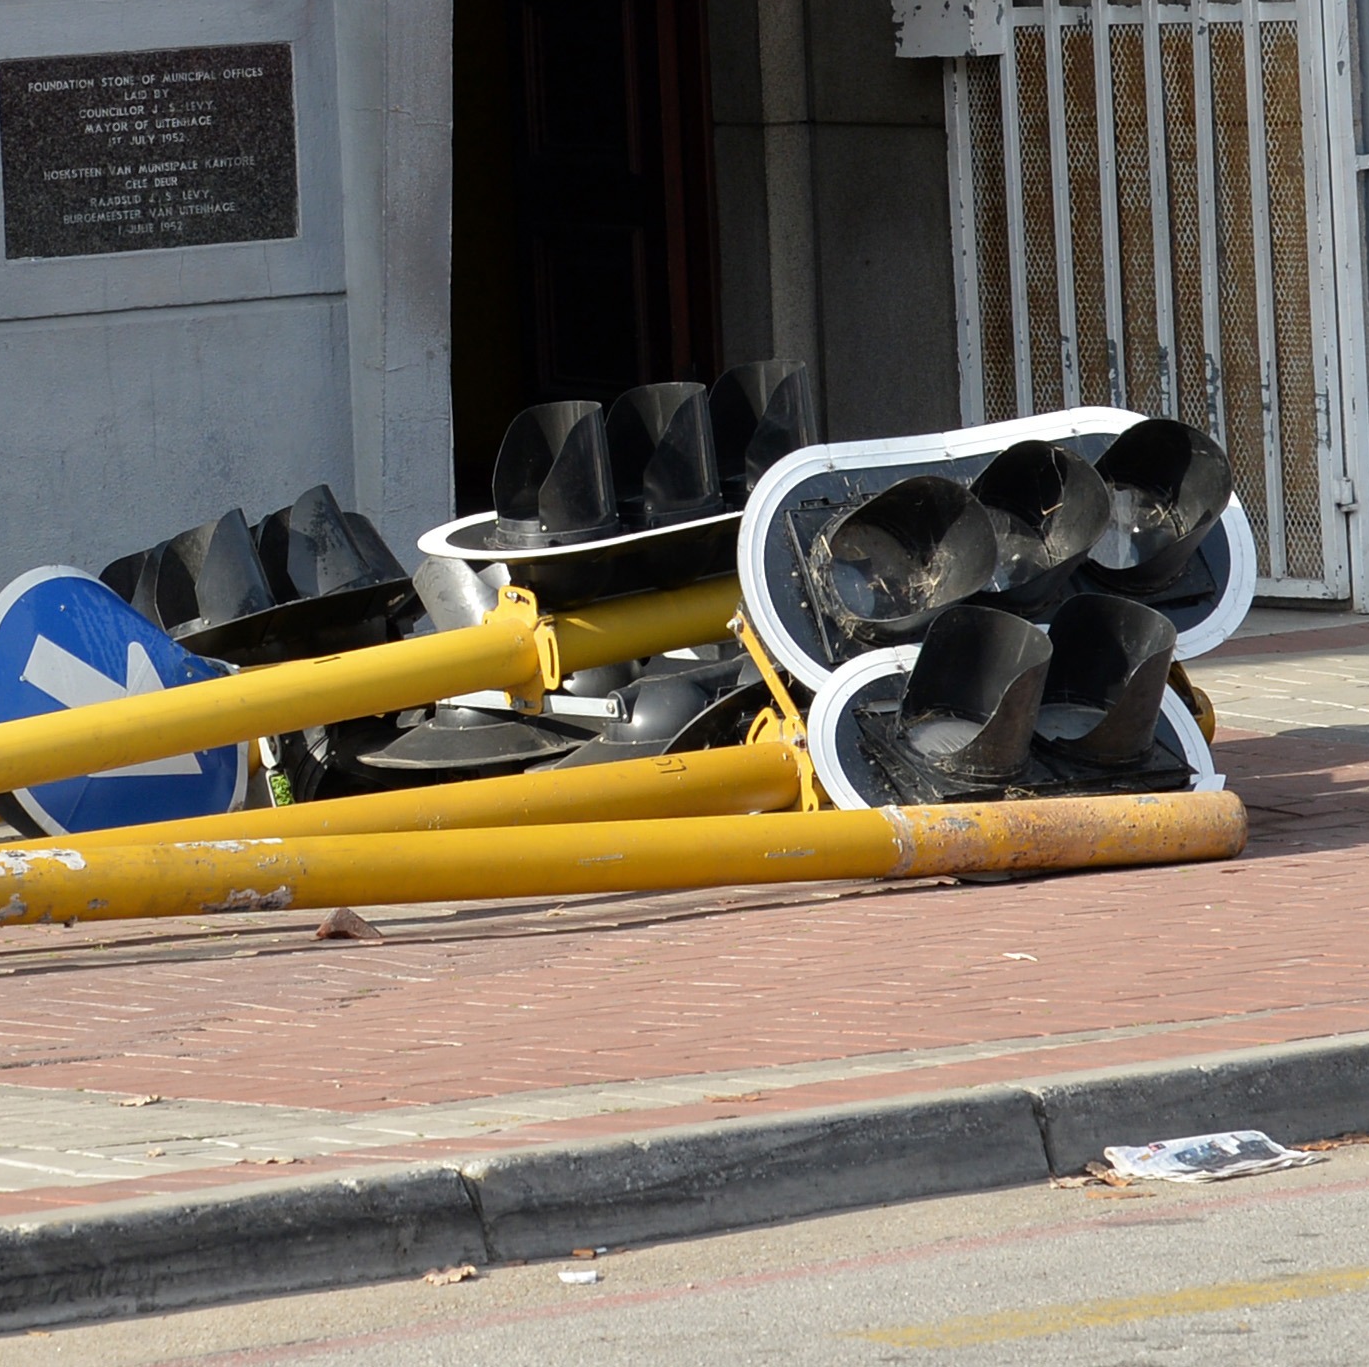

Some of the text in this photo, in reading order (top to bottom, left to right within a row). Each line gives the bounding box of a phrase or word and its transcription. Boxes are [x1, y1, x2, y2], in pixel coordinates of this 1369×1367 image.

[28, 67, 263, 92] FOUNDATION STONE OF MUNICIPAL OFFICES
[124, 88, 170, 101] LAID BY
[79, 105, 144, 119] COUNCILLOR
[84, 116, 212, 134] MAYOR OF UITENHAGE
[130, 134, 155, 146] JULY
[44, 156, 255, 180] HOEKSTEEN VAN MUNISIPALE KANTORE
[154, 177, 178, 188] DEUR
[90, 194, 142, 208] RAADSLID
[63, 209, 142, 224] BURGEMEESTER
[149, 206, 174, 218] VAN
